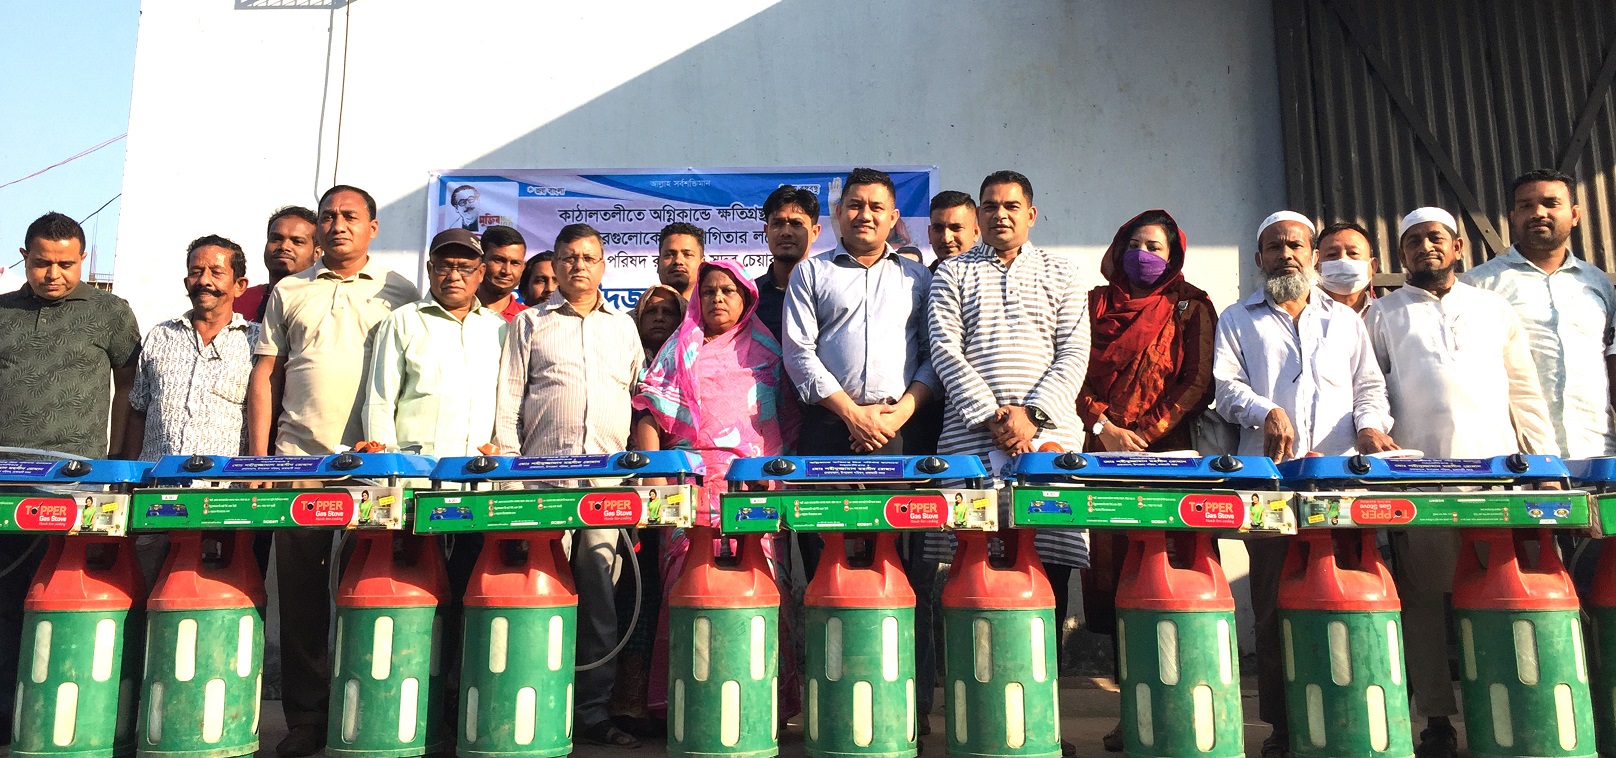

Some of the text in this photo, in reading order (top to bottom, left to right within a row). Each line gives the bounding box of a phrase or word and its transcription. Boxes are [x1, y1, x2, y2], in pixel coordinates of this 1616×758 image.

[650, 180, 671, 188] আল্লাহ
[557, 204, 646, 223] কাঠালতলীতে
[600, 231, 661, 245] রগুলোকে
[704, 227, 748, 245] াগিতার
[607, 251, 648, 268] পরিষদ
[25, 504, 67, 516] TOPPER
[301, 499, 344, 511] TOPPER
[588, 499, 631, 511] TOPPER
[894, 502, 938, 513] TOPPER
[1189, 501, 1234, 513] TOPPER
[1360, 510, 1409, 519] TOPPER
